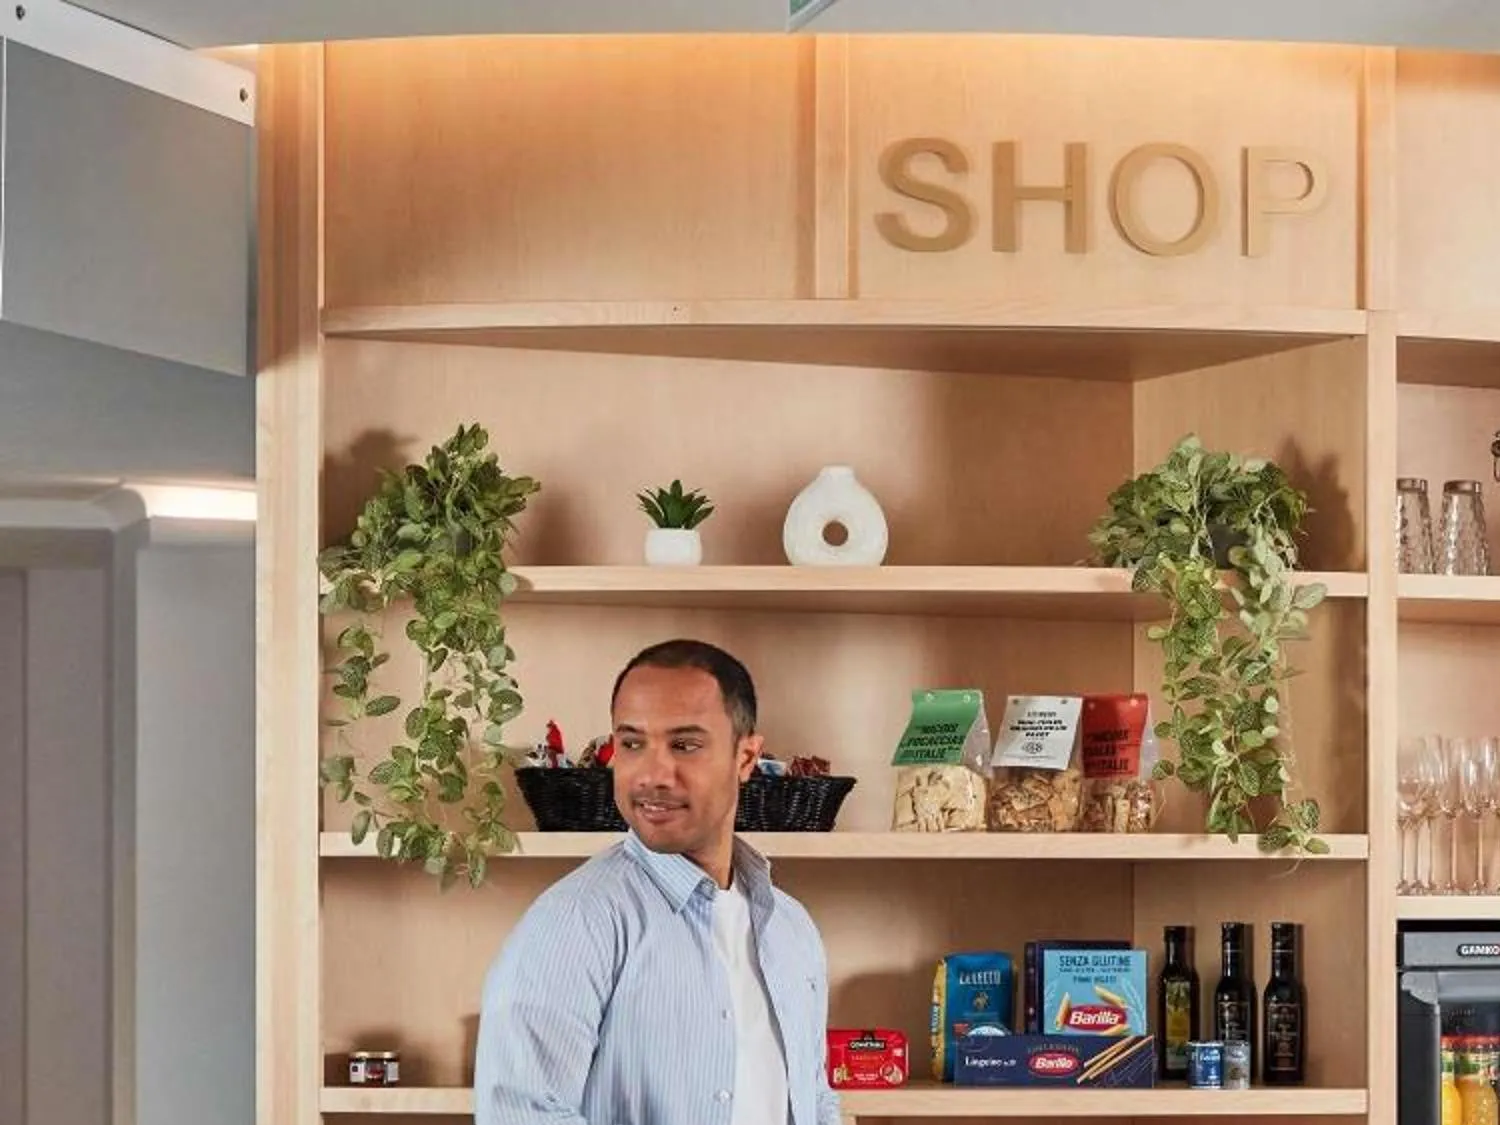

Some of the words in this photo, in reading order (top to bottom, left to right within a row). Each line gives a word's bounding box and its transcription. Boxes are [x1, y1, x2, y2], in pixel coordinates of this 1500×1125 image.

[873, 137, 1330, 257] SHOP
[1059, 955, 1089, 966] SENZA
[1069, 1010, 1120, 1025] Barilla
[1035, 1057, 1073, 1069] Barilla
